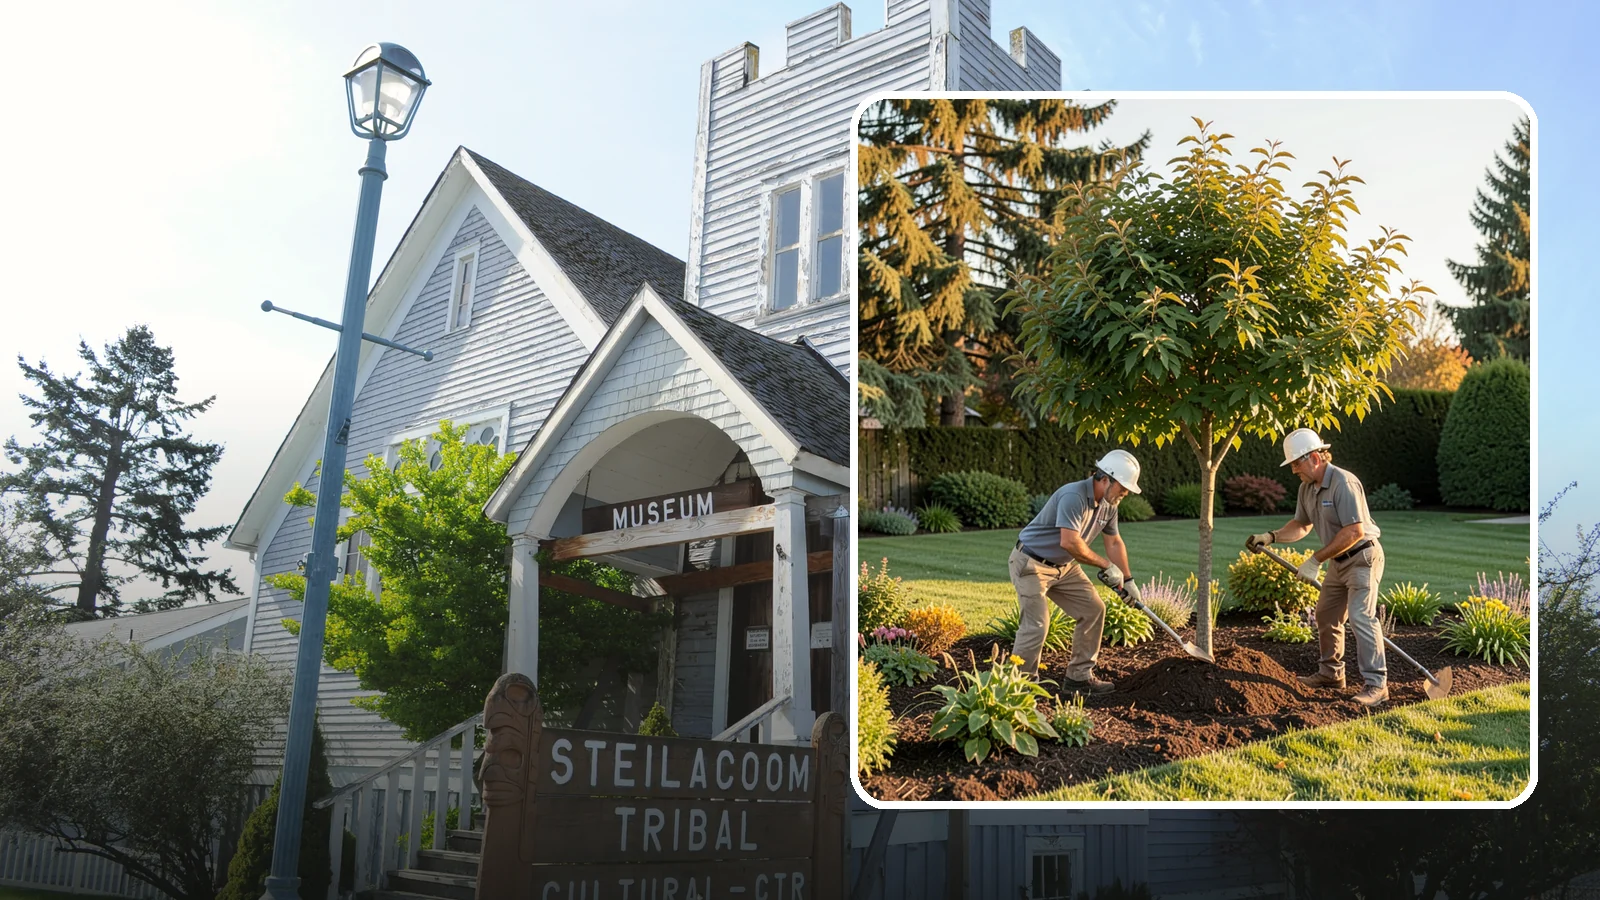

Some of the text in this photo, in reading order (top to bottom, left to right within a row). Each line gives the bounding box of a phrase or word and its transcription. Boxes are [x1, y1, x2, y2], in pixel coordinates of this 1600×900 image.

[613, 492, 714, 531] MUSEUM
[550, 738, 809, 792] STEILACOOM
[615, 806, 758, 851] TRIBAL
